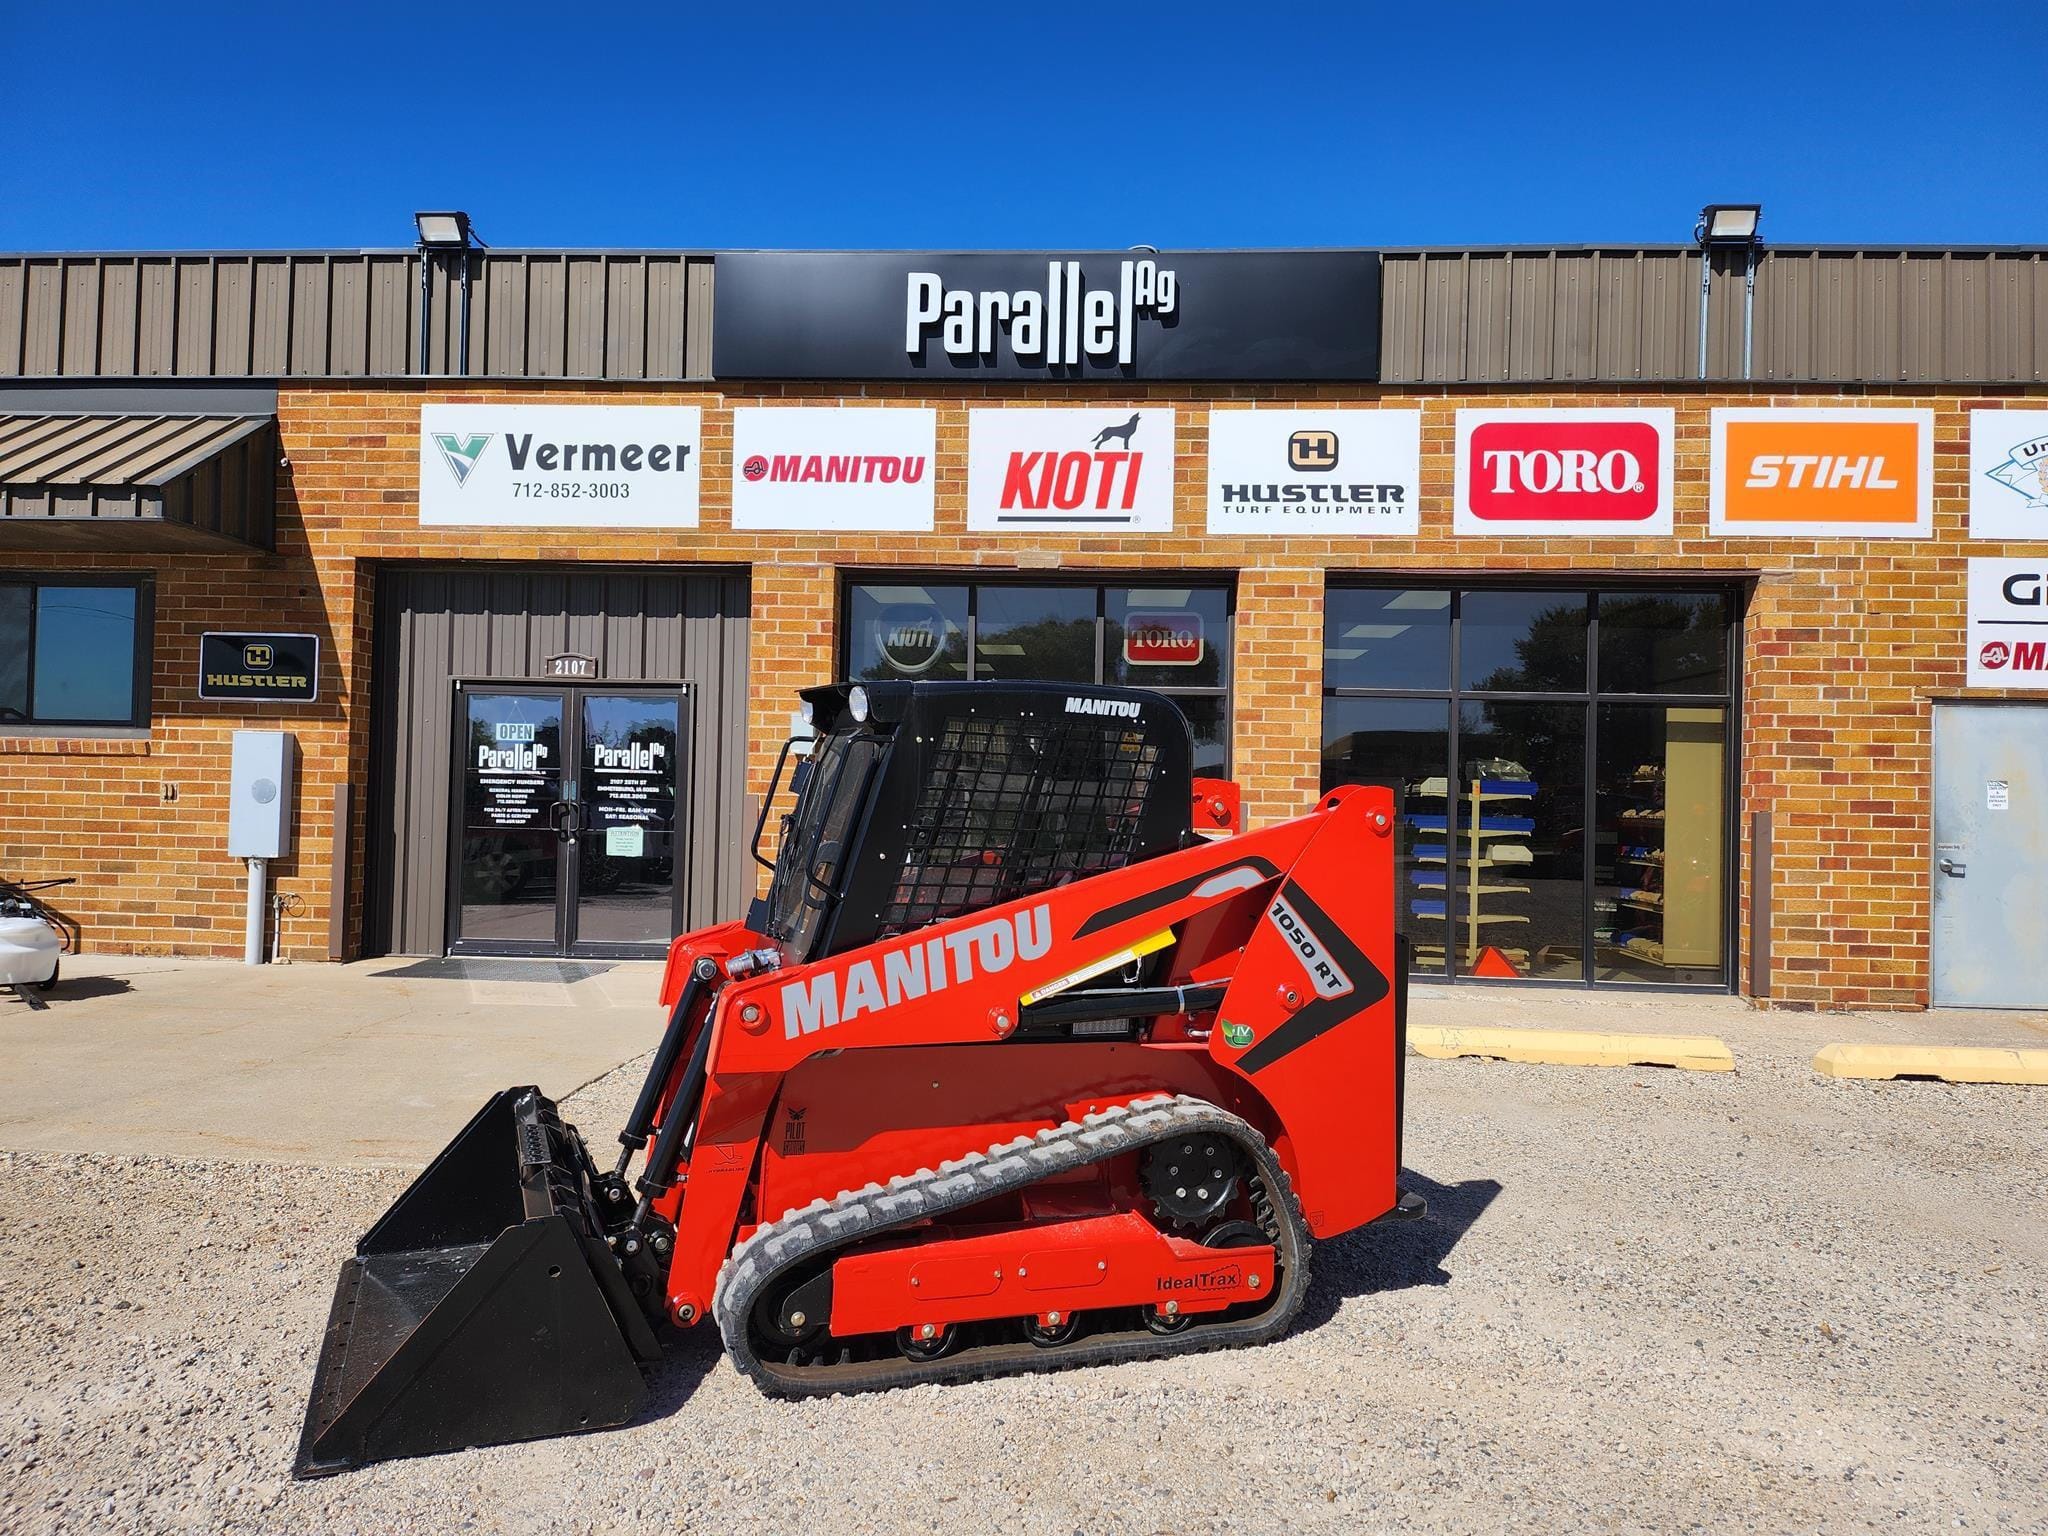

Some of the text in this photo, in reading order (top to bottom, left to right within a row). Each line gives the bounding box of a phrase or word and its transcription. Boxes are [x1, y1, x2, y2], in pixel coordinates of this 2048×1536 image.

[505, 433, 691, 472] Vermeer
[769, 455, 926, 484] MANITOU
[1483, 449, 1640, 494] TORO
[1745, 455, 1898, 490] STIHL
[999, 450, 1144, 510] KIOTI
[512, 482, 631, 498] 712-852-3003
[1221, 484, 1405, 503] HUSTLER
[1223, 506, 1405, 514] TURF EQUIPMENT
[1132, 630, 1194, 648] TORO
[555, 660, 586, 675] 2107
[206, 674, 307, 688] HUSTLER
[1065, 697, 1141, 718] MANITOU
[500, 725, 532, 739] OPEN
[1272, 902, 1342, 989] 1050 RT
[781, 904, 1053, 1040] MANITOU
[785, 1122, 805, 1140] PILOT
[1157, 1273, 1237, 1290] IdealTrax
